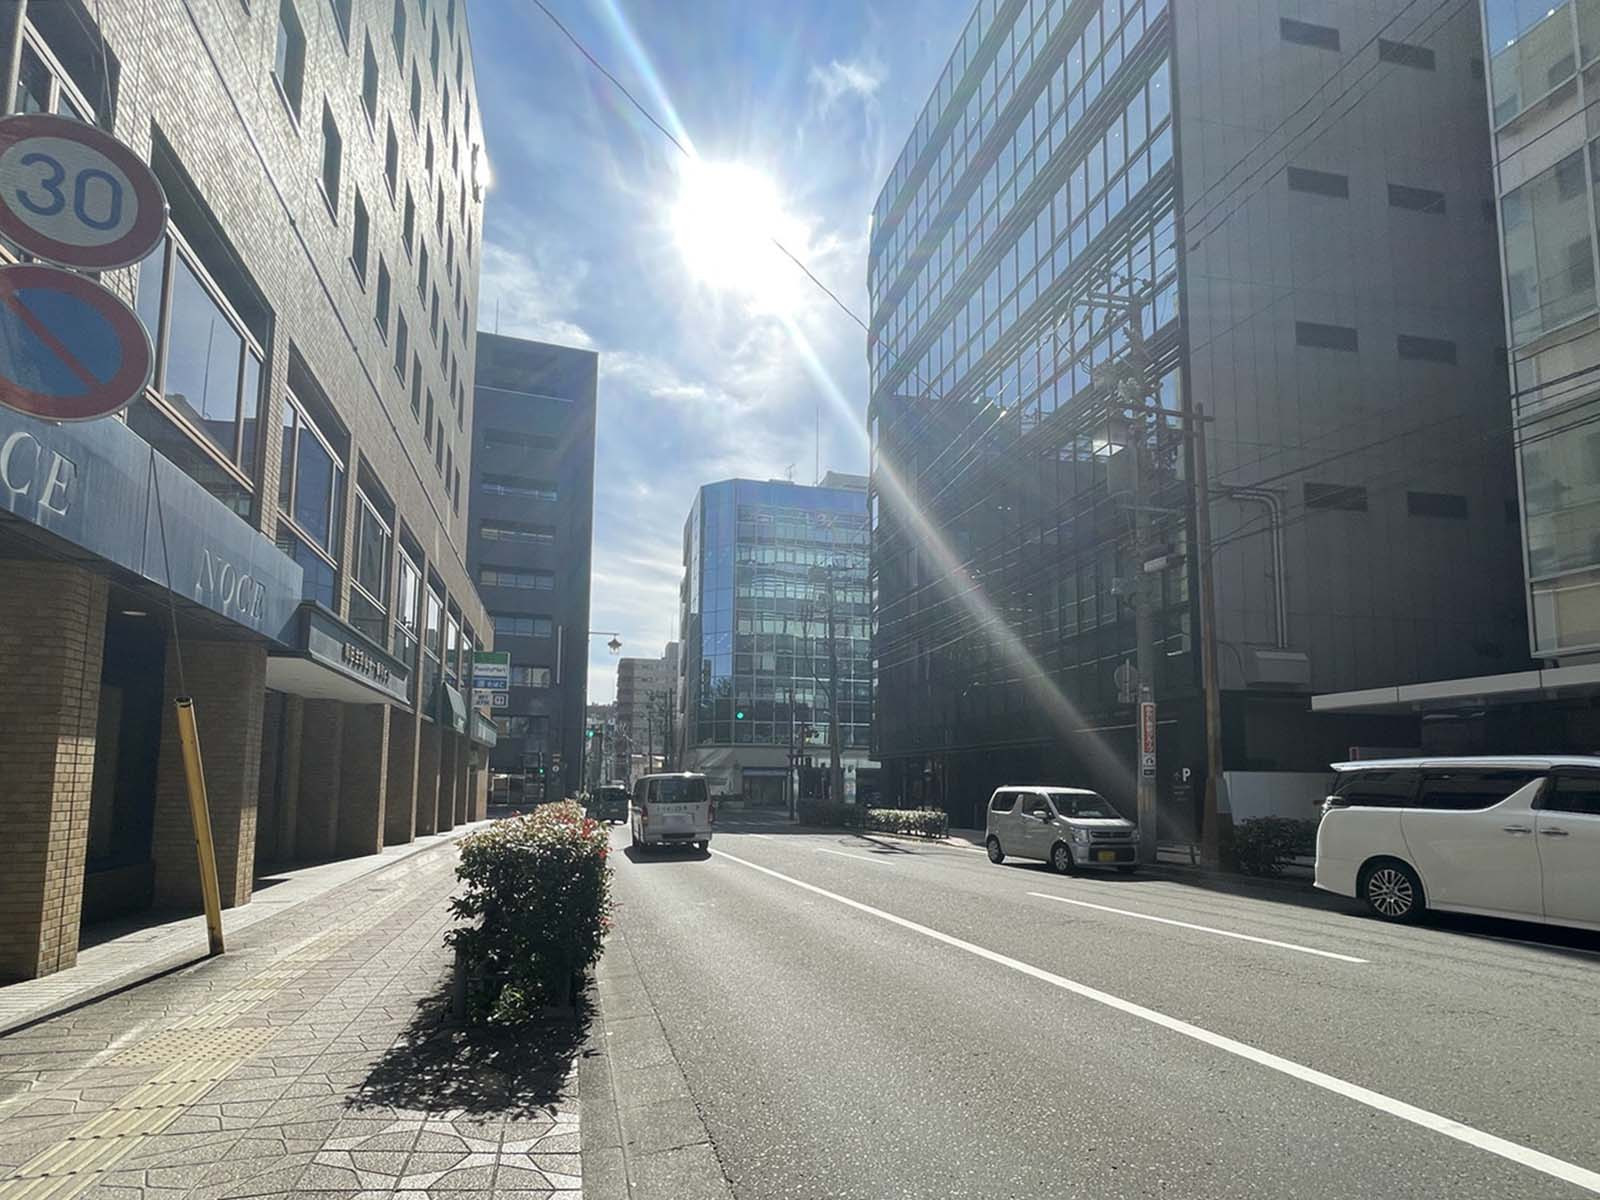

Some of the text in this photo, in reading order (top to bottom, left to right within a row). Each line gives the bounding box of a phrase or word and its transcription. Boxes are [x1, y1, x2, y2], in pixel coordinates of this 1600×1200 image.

[16, 152, 123, 231] 30
[194, 549, 266, 619] NOCE
[1182, 768, 1191, 782] P
